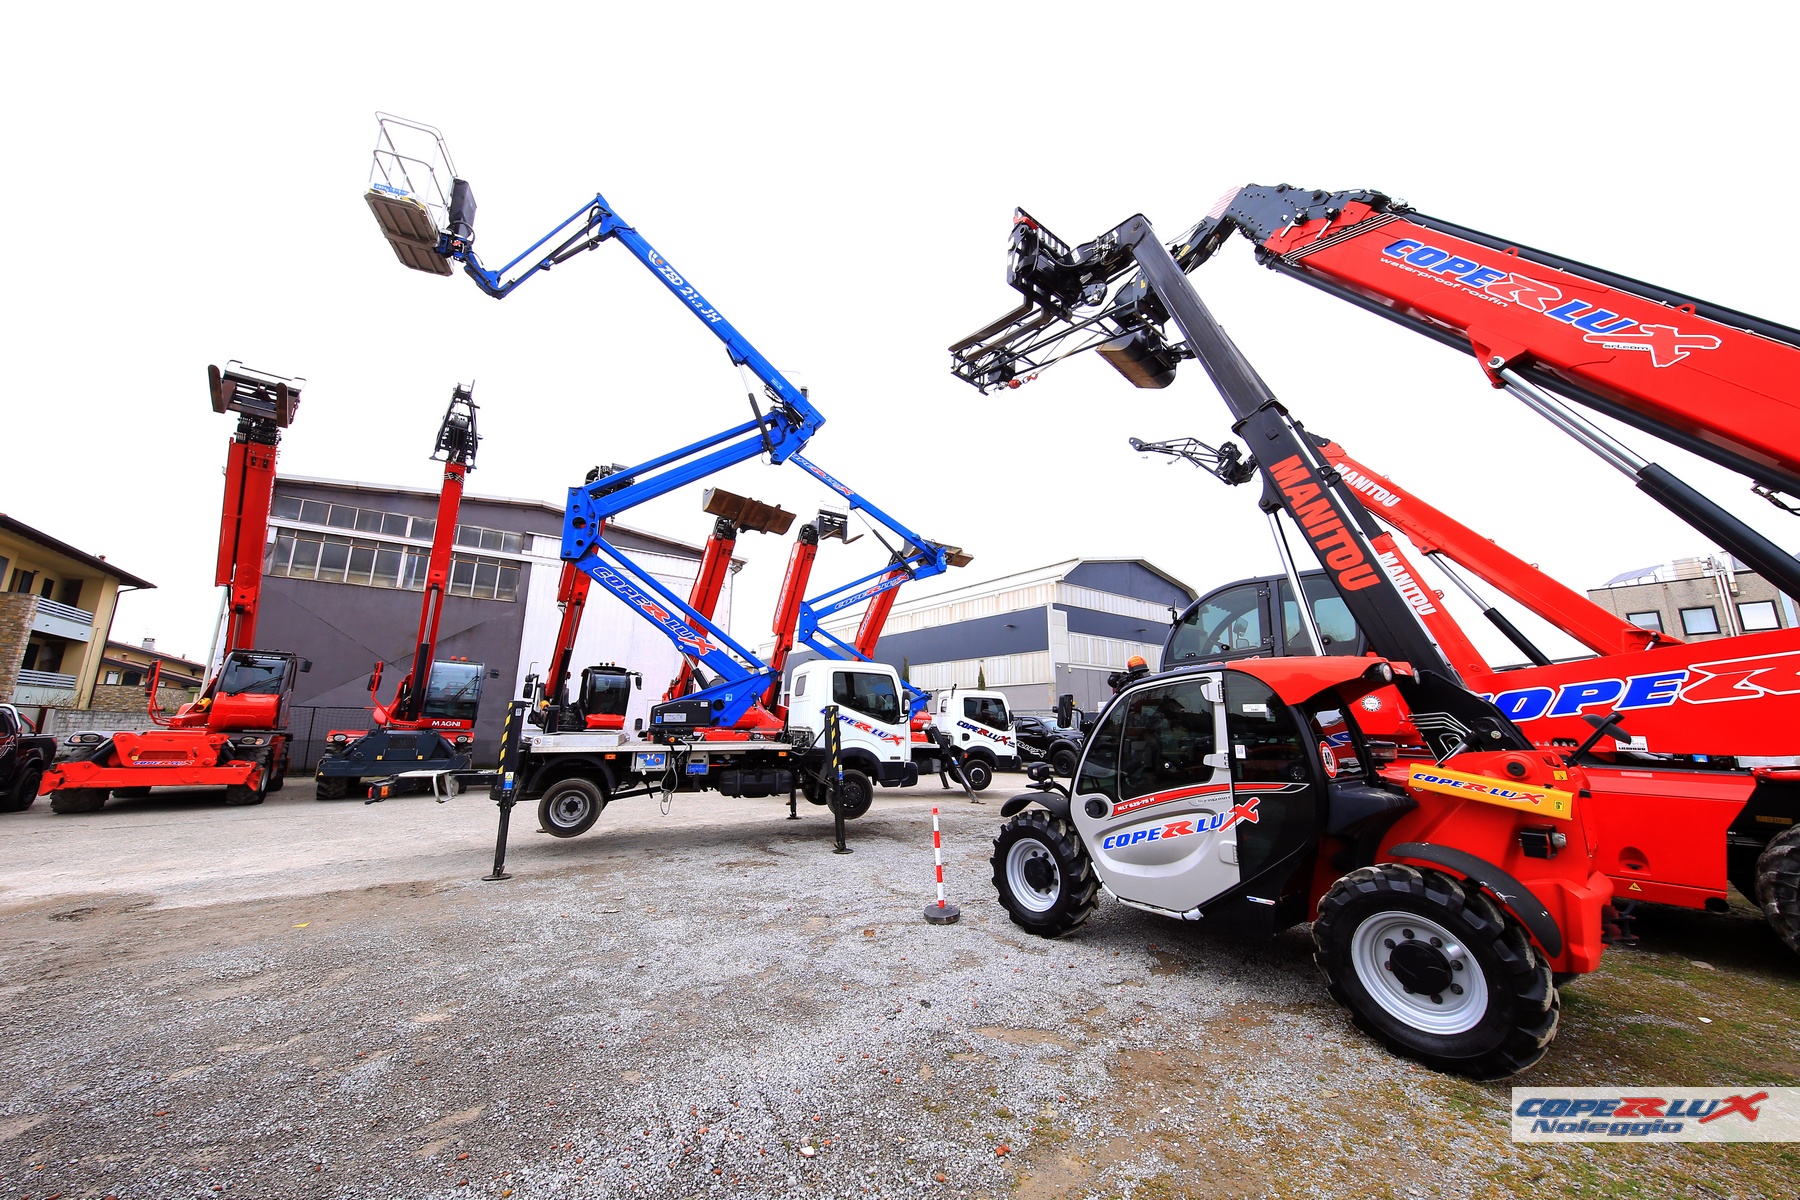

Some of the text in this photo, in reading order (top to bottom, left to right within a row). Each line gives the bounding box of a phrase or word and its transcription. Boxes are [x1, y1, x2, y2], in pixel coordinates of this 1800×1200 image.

[657, 265, 684, 286] ZED
[700, 308, 722, 323] JH
[1379, 257, 1463, 291] waterproof
[1382, 238, 1722, 368] COPERLUX
[1333, 463, 1401, 507] MANITOU
[1269, 454, 1381, 591] MANITOU
[1380, 551, 1437, 616] MANITOU
[593, 567, 717, 656] COPERLUX
[1472, 650, 1800, 723] OPER
[820, 708, 904, 746] PERLUX
[957, 720, 1012, 746] COPERLUX
[1413, 773, 1546, 805] COPERLUX
[1102, 797, 1260, 850] COPERLUX
